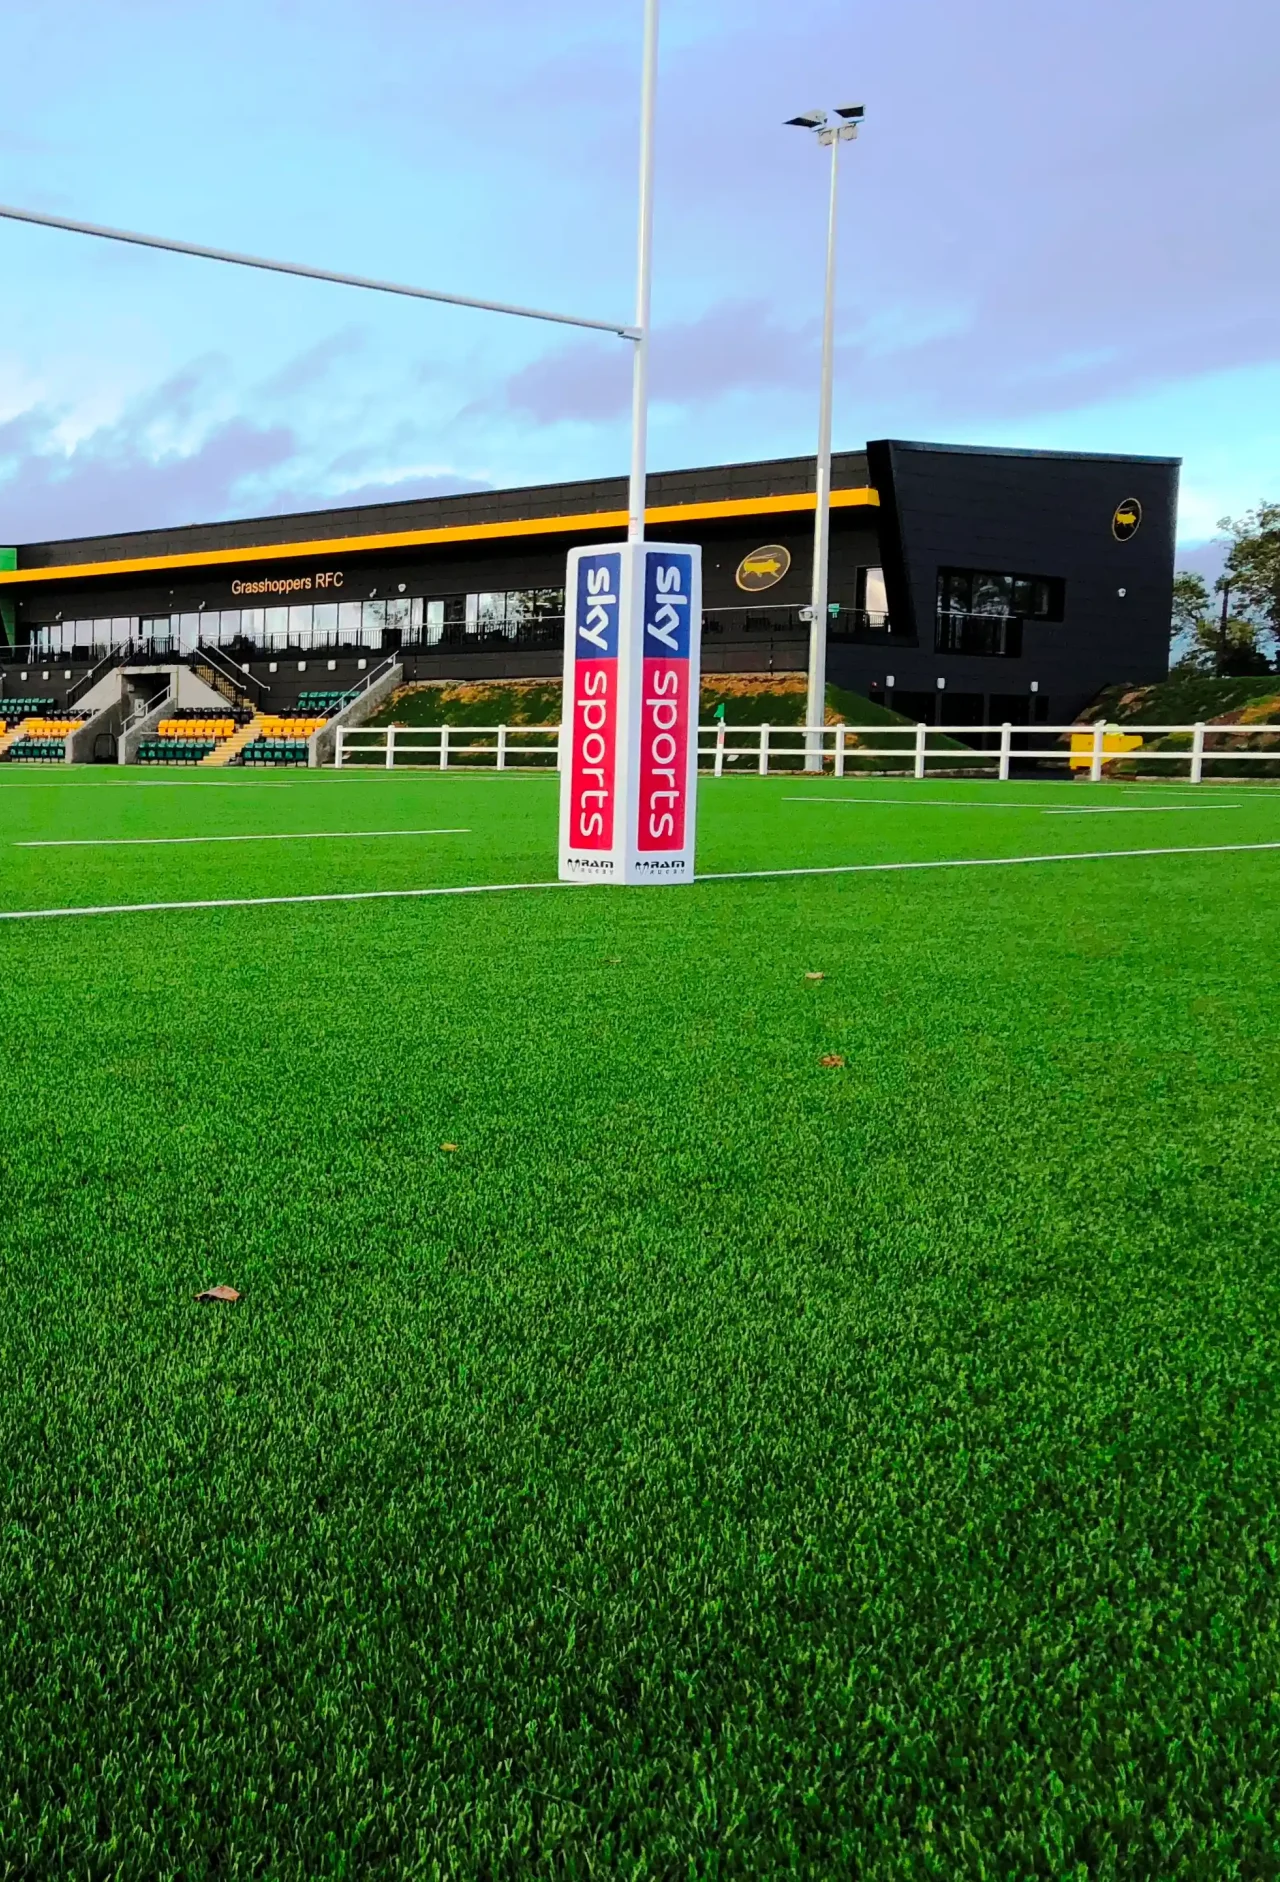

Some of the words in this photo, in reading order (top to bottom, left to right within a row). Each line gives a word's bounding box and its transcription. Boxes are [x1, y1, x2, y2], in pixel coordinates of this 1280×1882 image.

[231, 577, 312, 595] Grasshoppers
[315, 571, 344, 588] RFC
[579, 566, 617, 651] sky
[647, 566, 688, 651] sky
[578, 670, 609, 838] sports
[646, 670, 680, 838] sports
[581, 860, 614, 868] RAM
[651, 860, 685, 868] RAM
